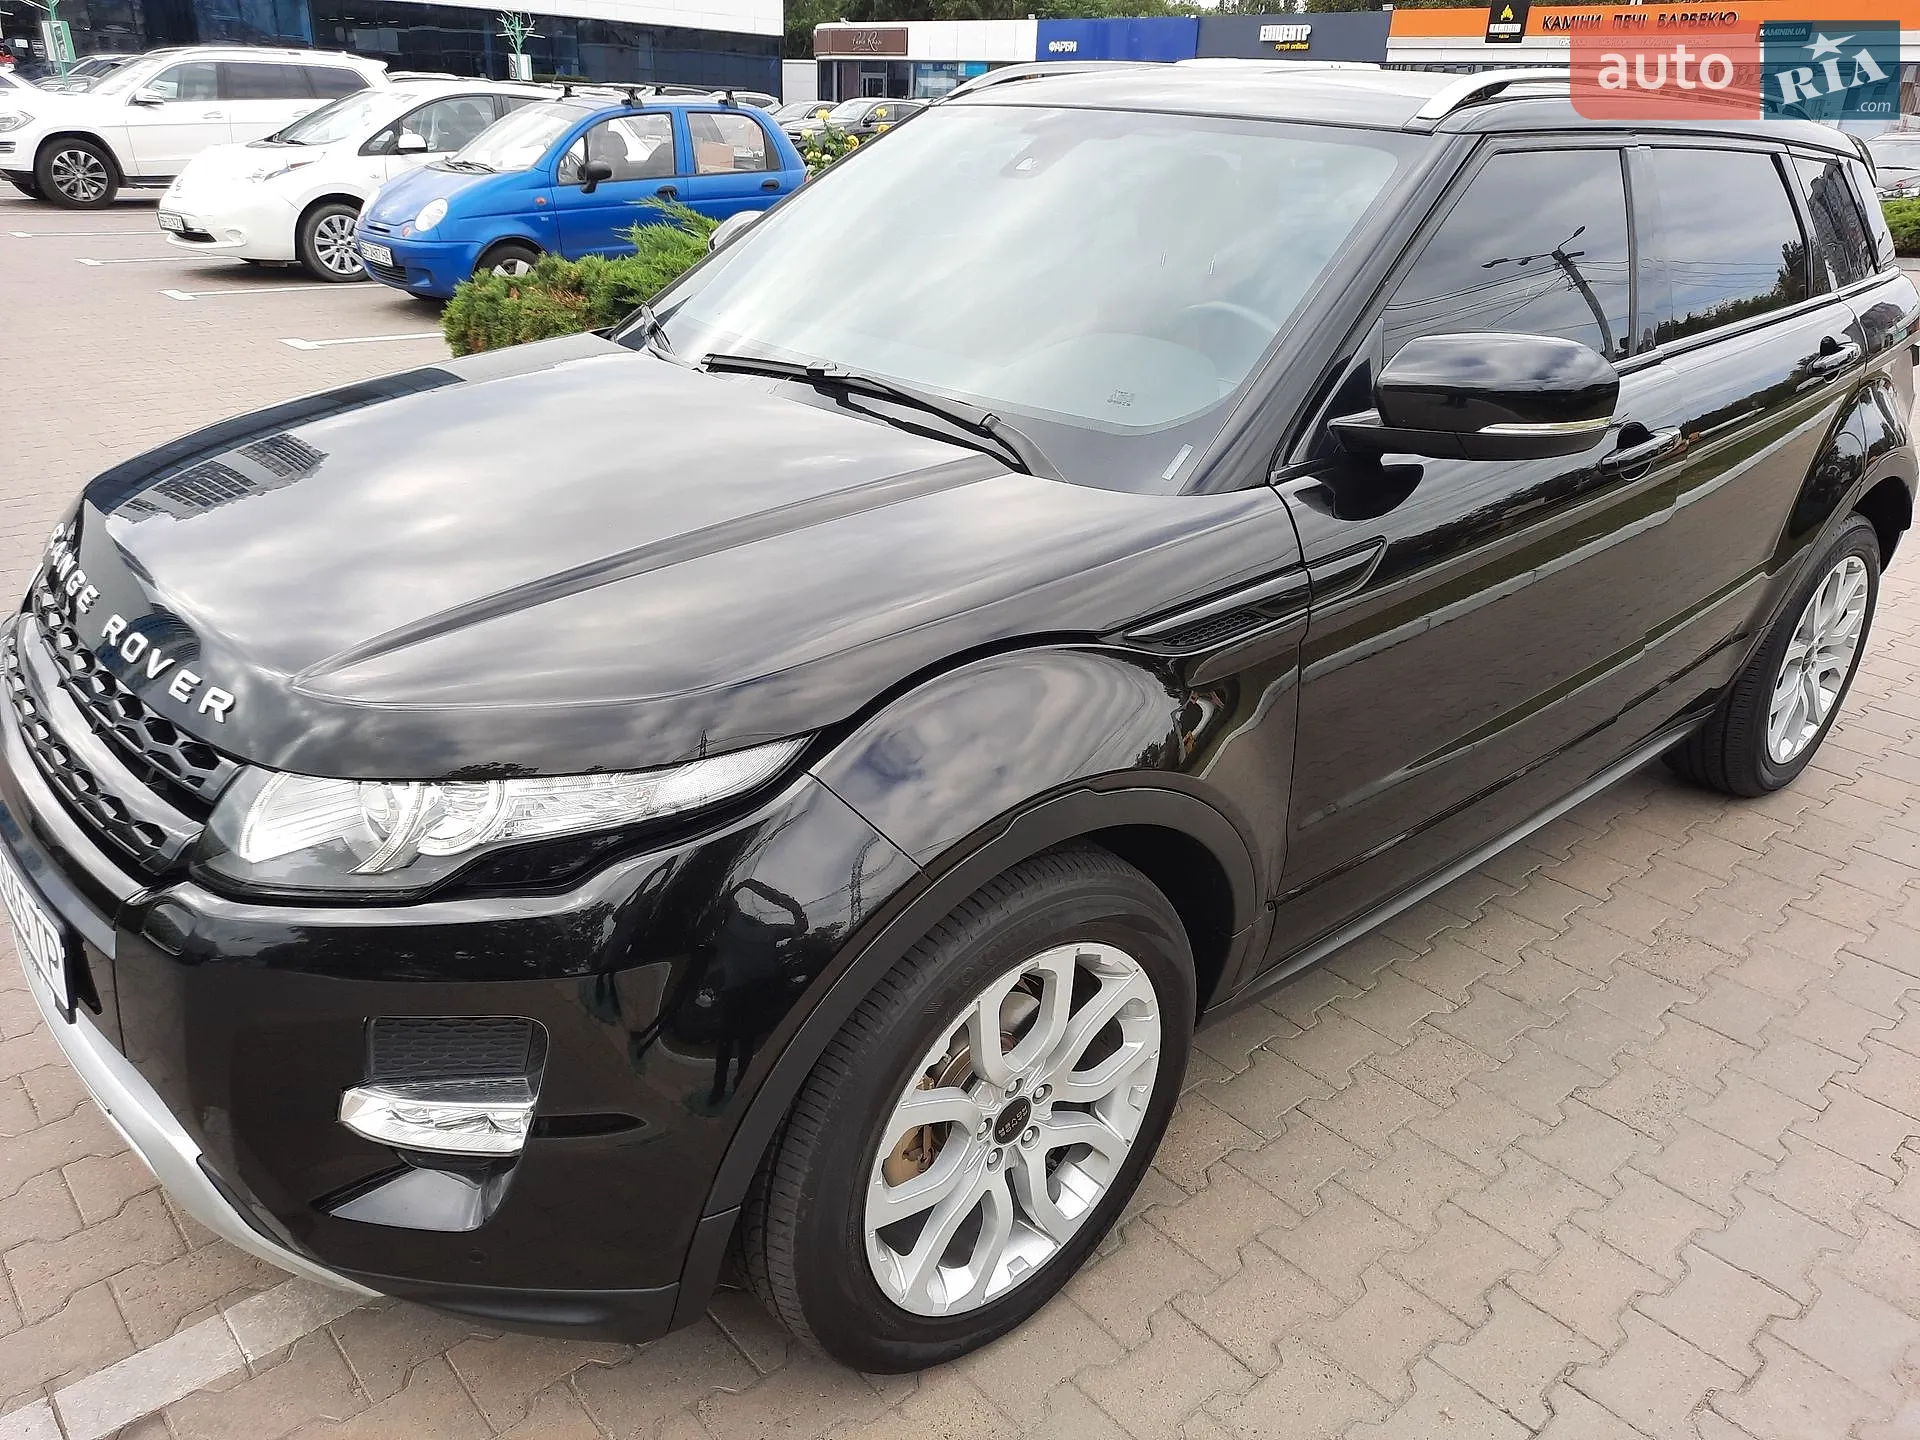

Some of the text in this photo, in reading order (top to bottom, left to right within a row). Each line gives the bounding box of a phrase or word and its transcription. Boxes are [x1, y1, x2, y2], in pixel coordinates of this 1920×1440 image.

[1612, 13, 1649, 29] ПЕЧІ
[1656, 11, 1738, 28] БАРБЕКЮ
[1049, 41, 1078, 52] ФАРБИ
[50, 523, 235, 723] RANGE ROVER
